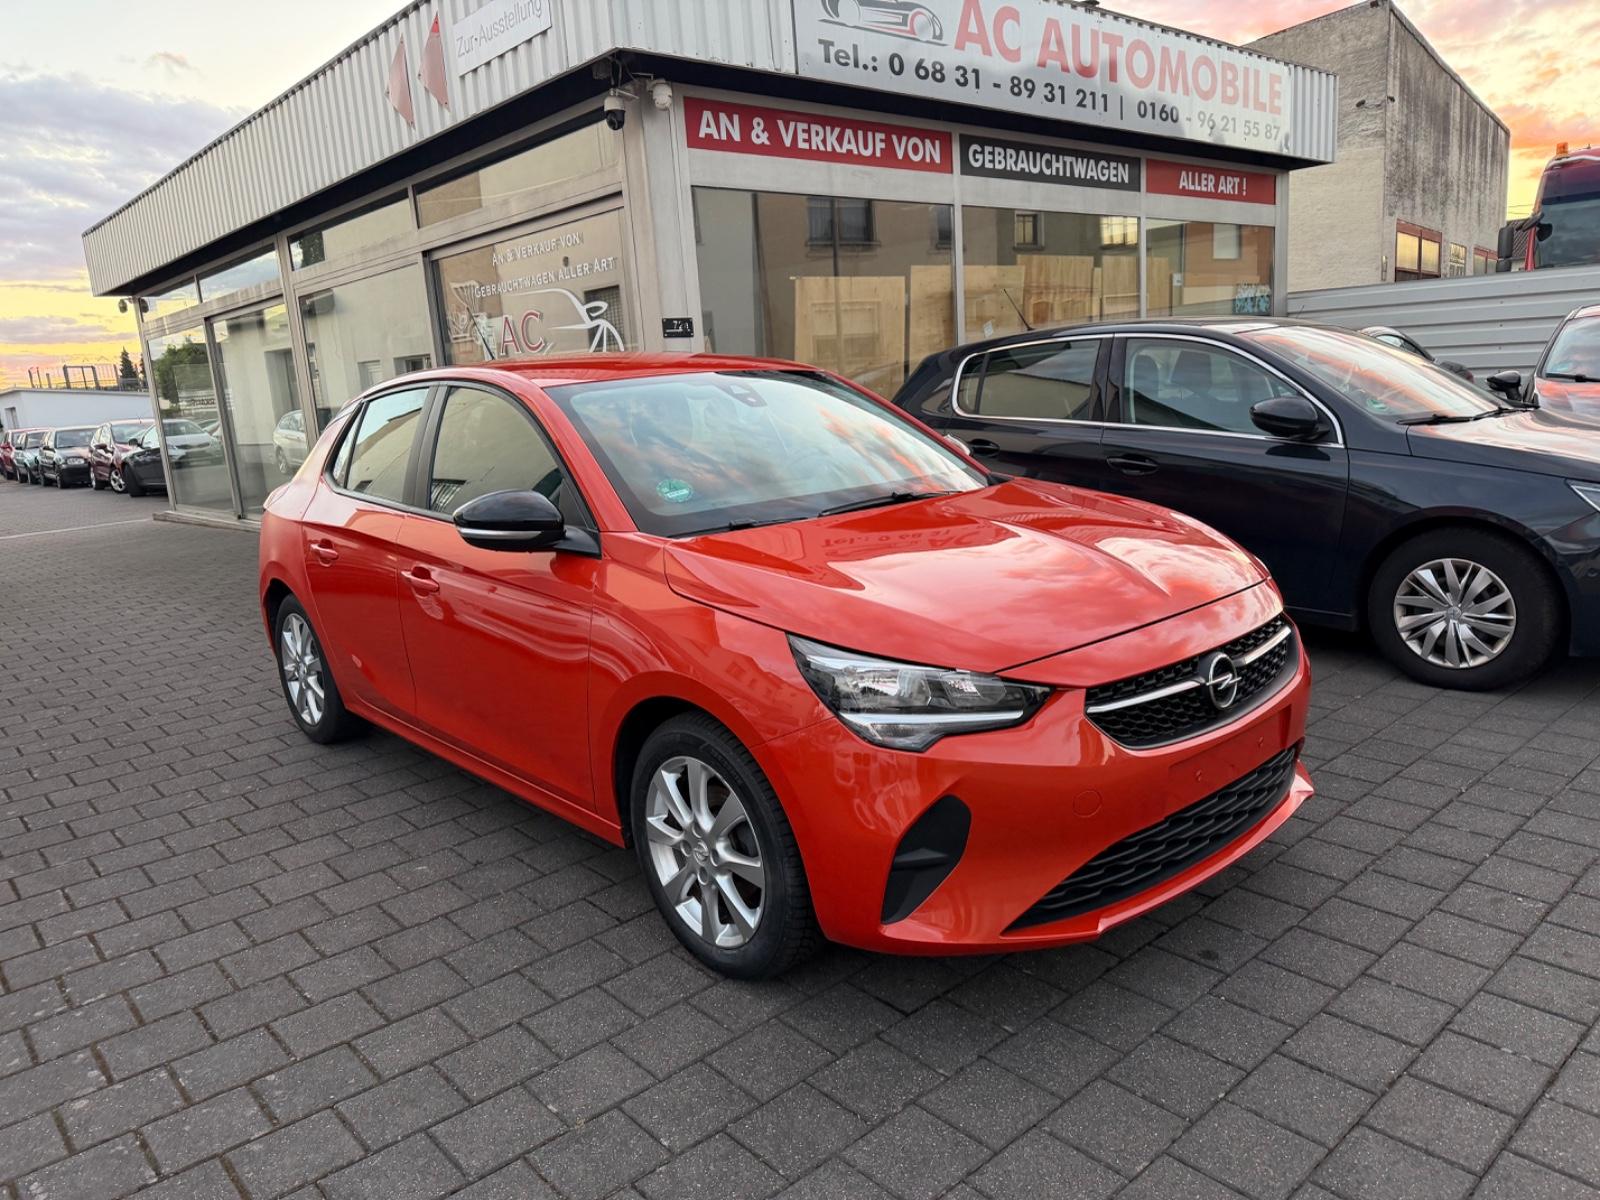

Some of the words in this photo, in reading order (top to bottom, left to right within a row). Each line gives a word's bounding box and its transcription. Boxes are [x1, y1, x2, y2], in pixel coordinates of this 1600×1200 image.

[456, 35, 474, 57] Zur
[479, 0, 542, 46] Ausstellung
[954, 0, 1021, 63] AC
[1036, 17, 1282, 116] AUTOMOBILE
[818, 38, 878, 72] Tel.:
[889, 53, 904, 76] 0
[915, 58, 946, 83] 68
[955, 65, 980, 90] 31
[1010, 75, 1036, 99] 89
[1043, 82, 1065, 105] 31
[1076, 88, 1108, 112] 211
[1137, 100, 1179, 123] 0160
[1197, 111, 1216, 132] 96
[1221, 116, 1236, 134] 21
[1243, 120, 1259, 137] 55
[1265, 123, 1280, 141] 87
[699, 110, 741, 142] AN
[751, 116, 770, 145] &
[777, 119, 886, 157] VERKAUF
[892, 134, 941, 164] VON
[968, 144, 1129, 184] GEBRAUCHTWAGEN
[1179, 170, 1214, 193] ALLER
[1218, 175, 1239, 195] ART
[515, 237, 557, 259] VERKAUF
[500, 310, 545, 356] AC
